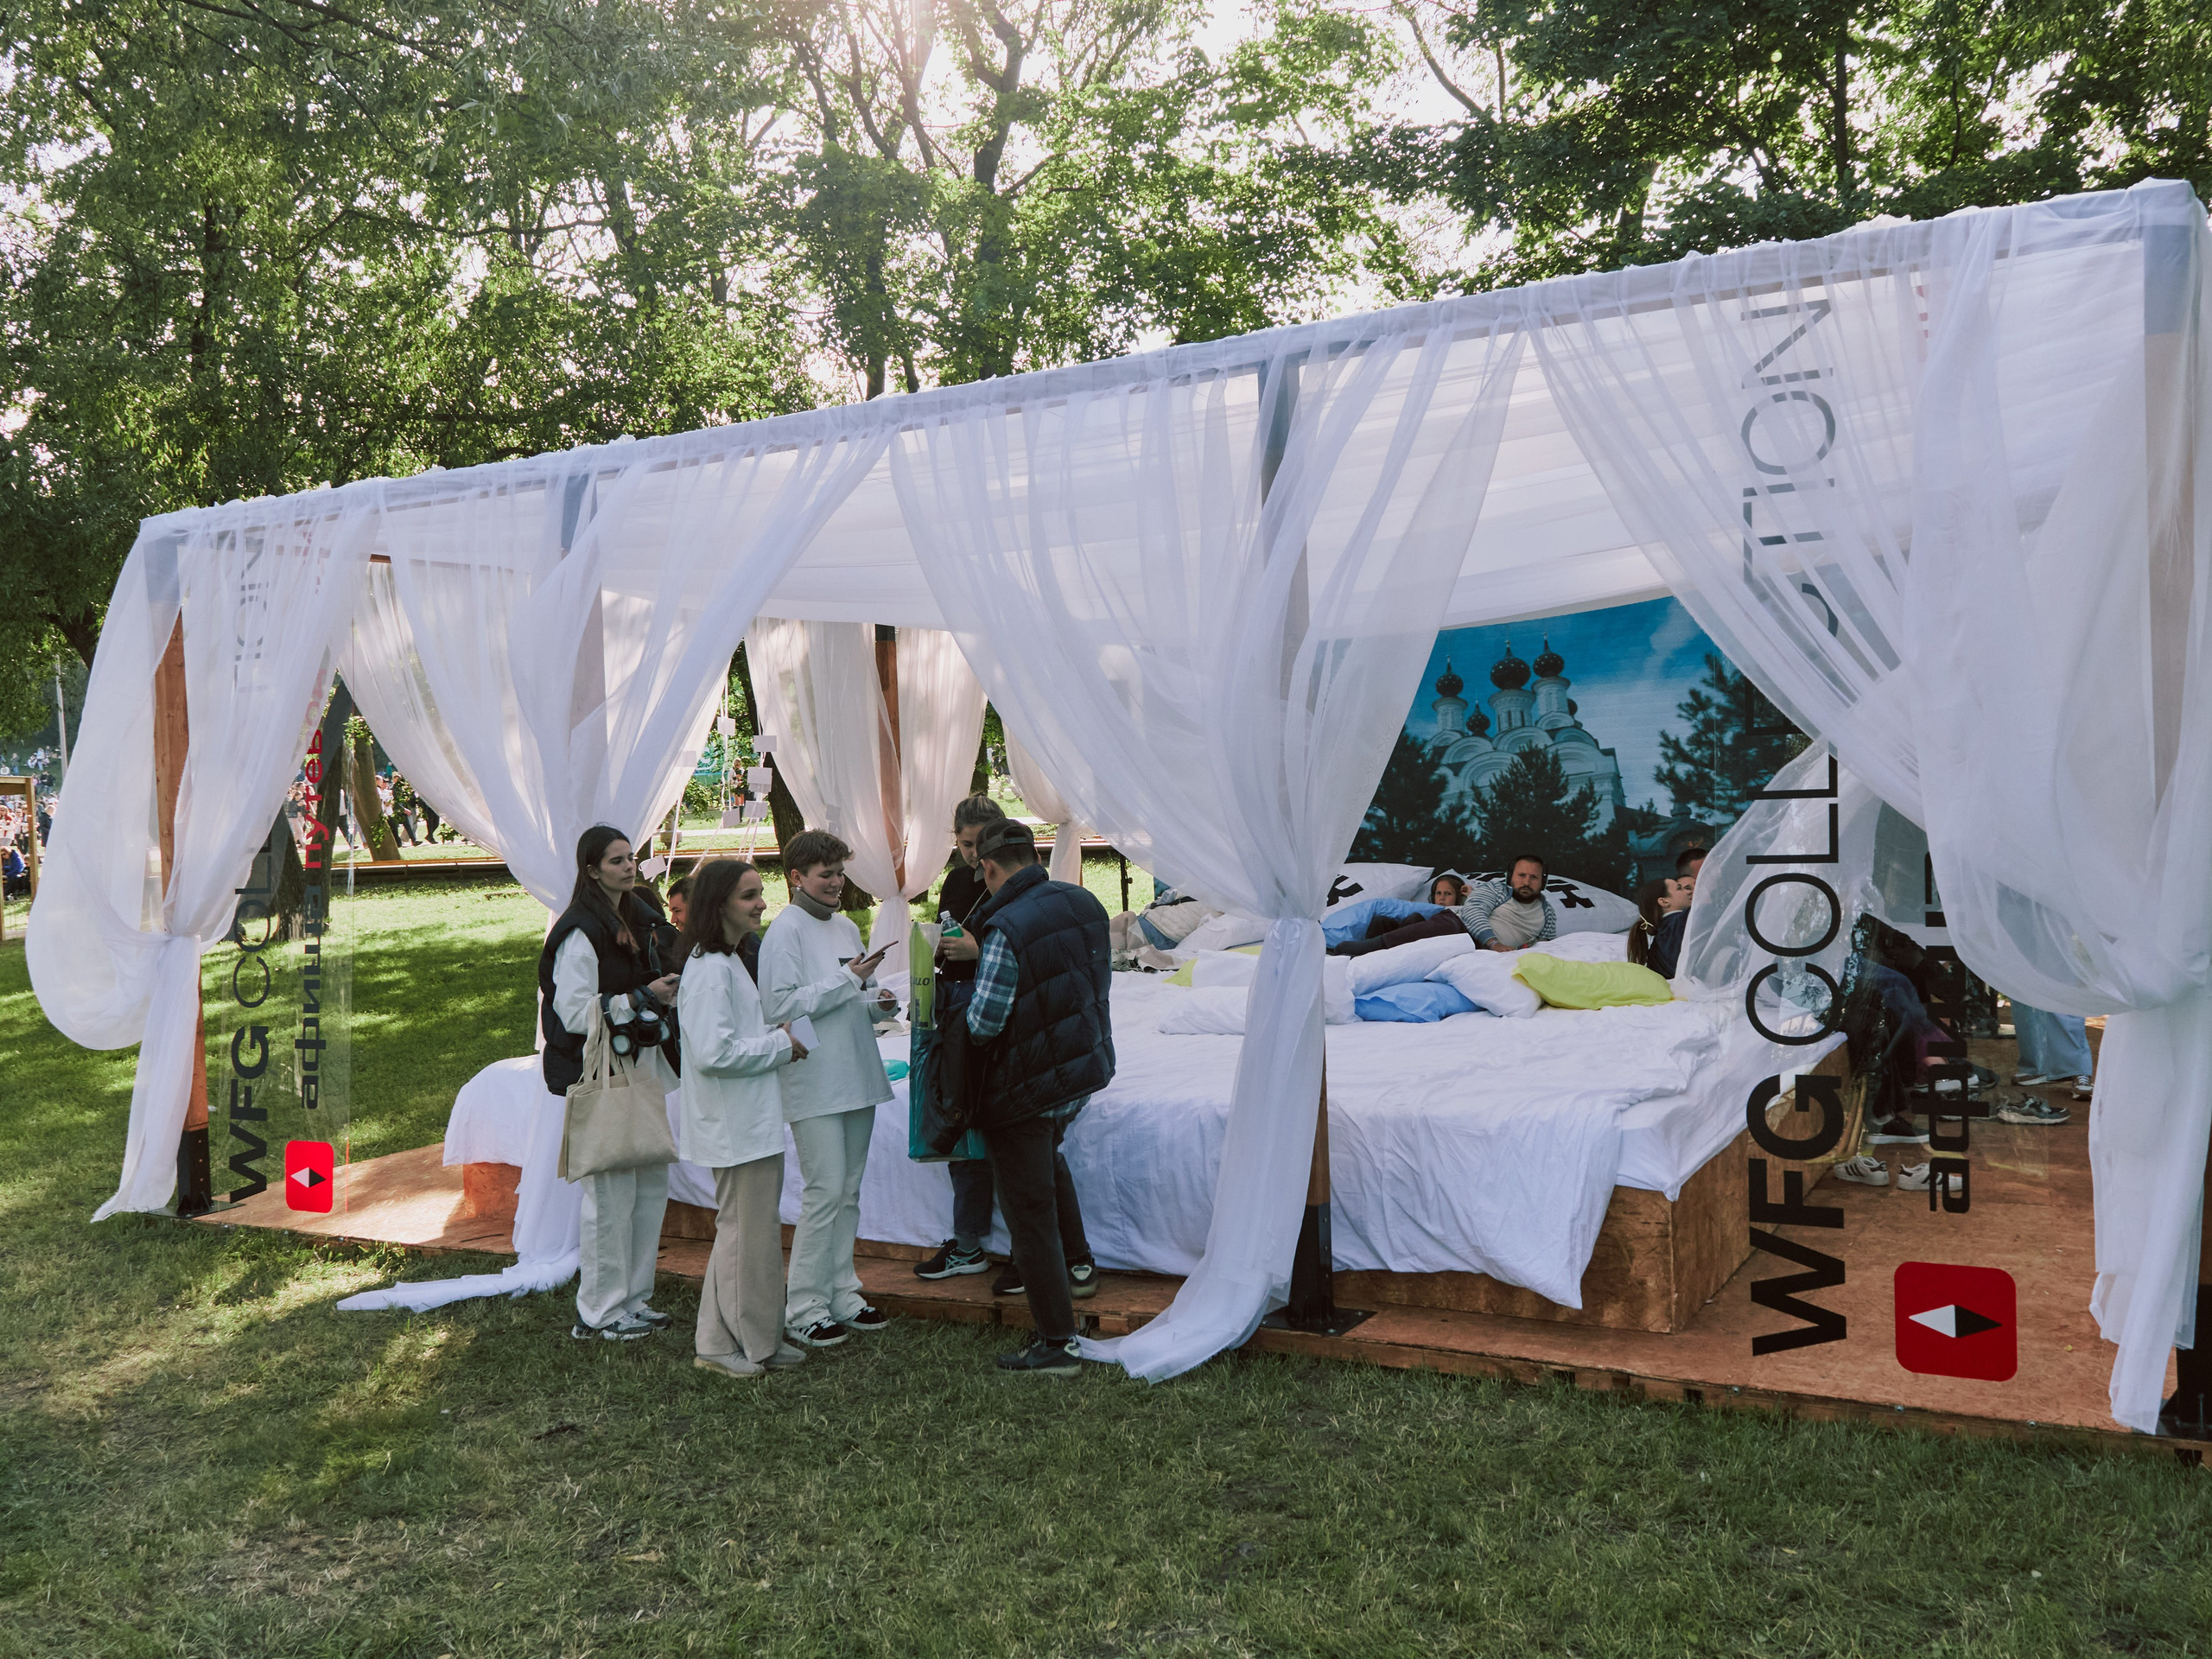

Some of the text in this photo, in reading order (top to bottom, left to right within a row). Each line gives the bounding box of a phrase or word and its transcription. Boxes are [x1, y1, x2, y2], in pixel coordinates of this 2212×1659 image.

[229, 1026, 270, 1204] WFG
[295, 884, 327, 1109] афиша
[1910, 850, 1991, 1215] афиш
[1747, 1073, 1847, 1357] WFG
